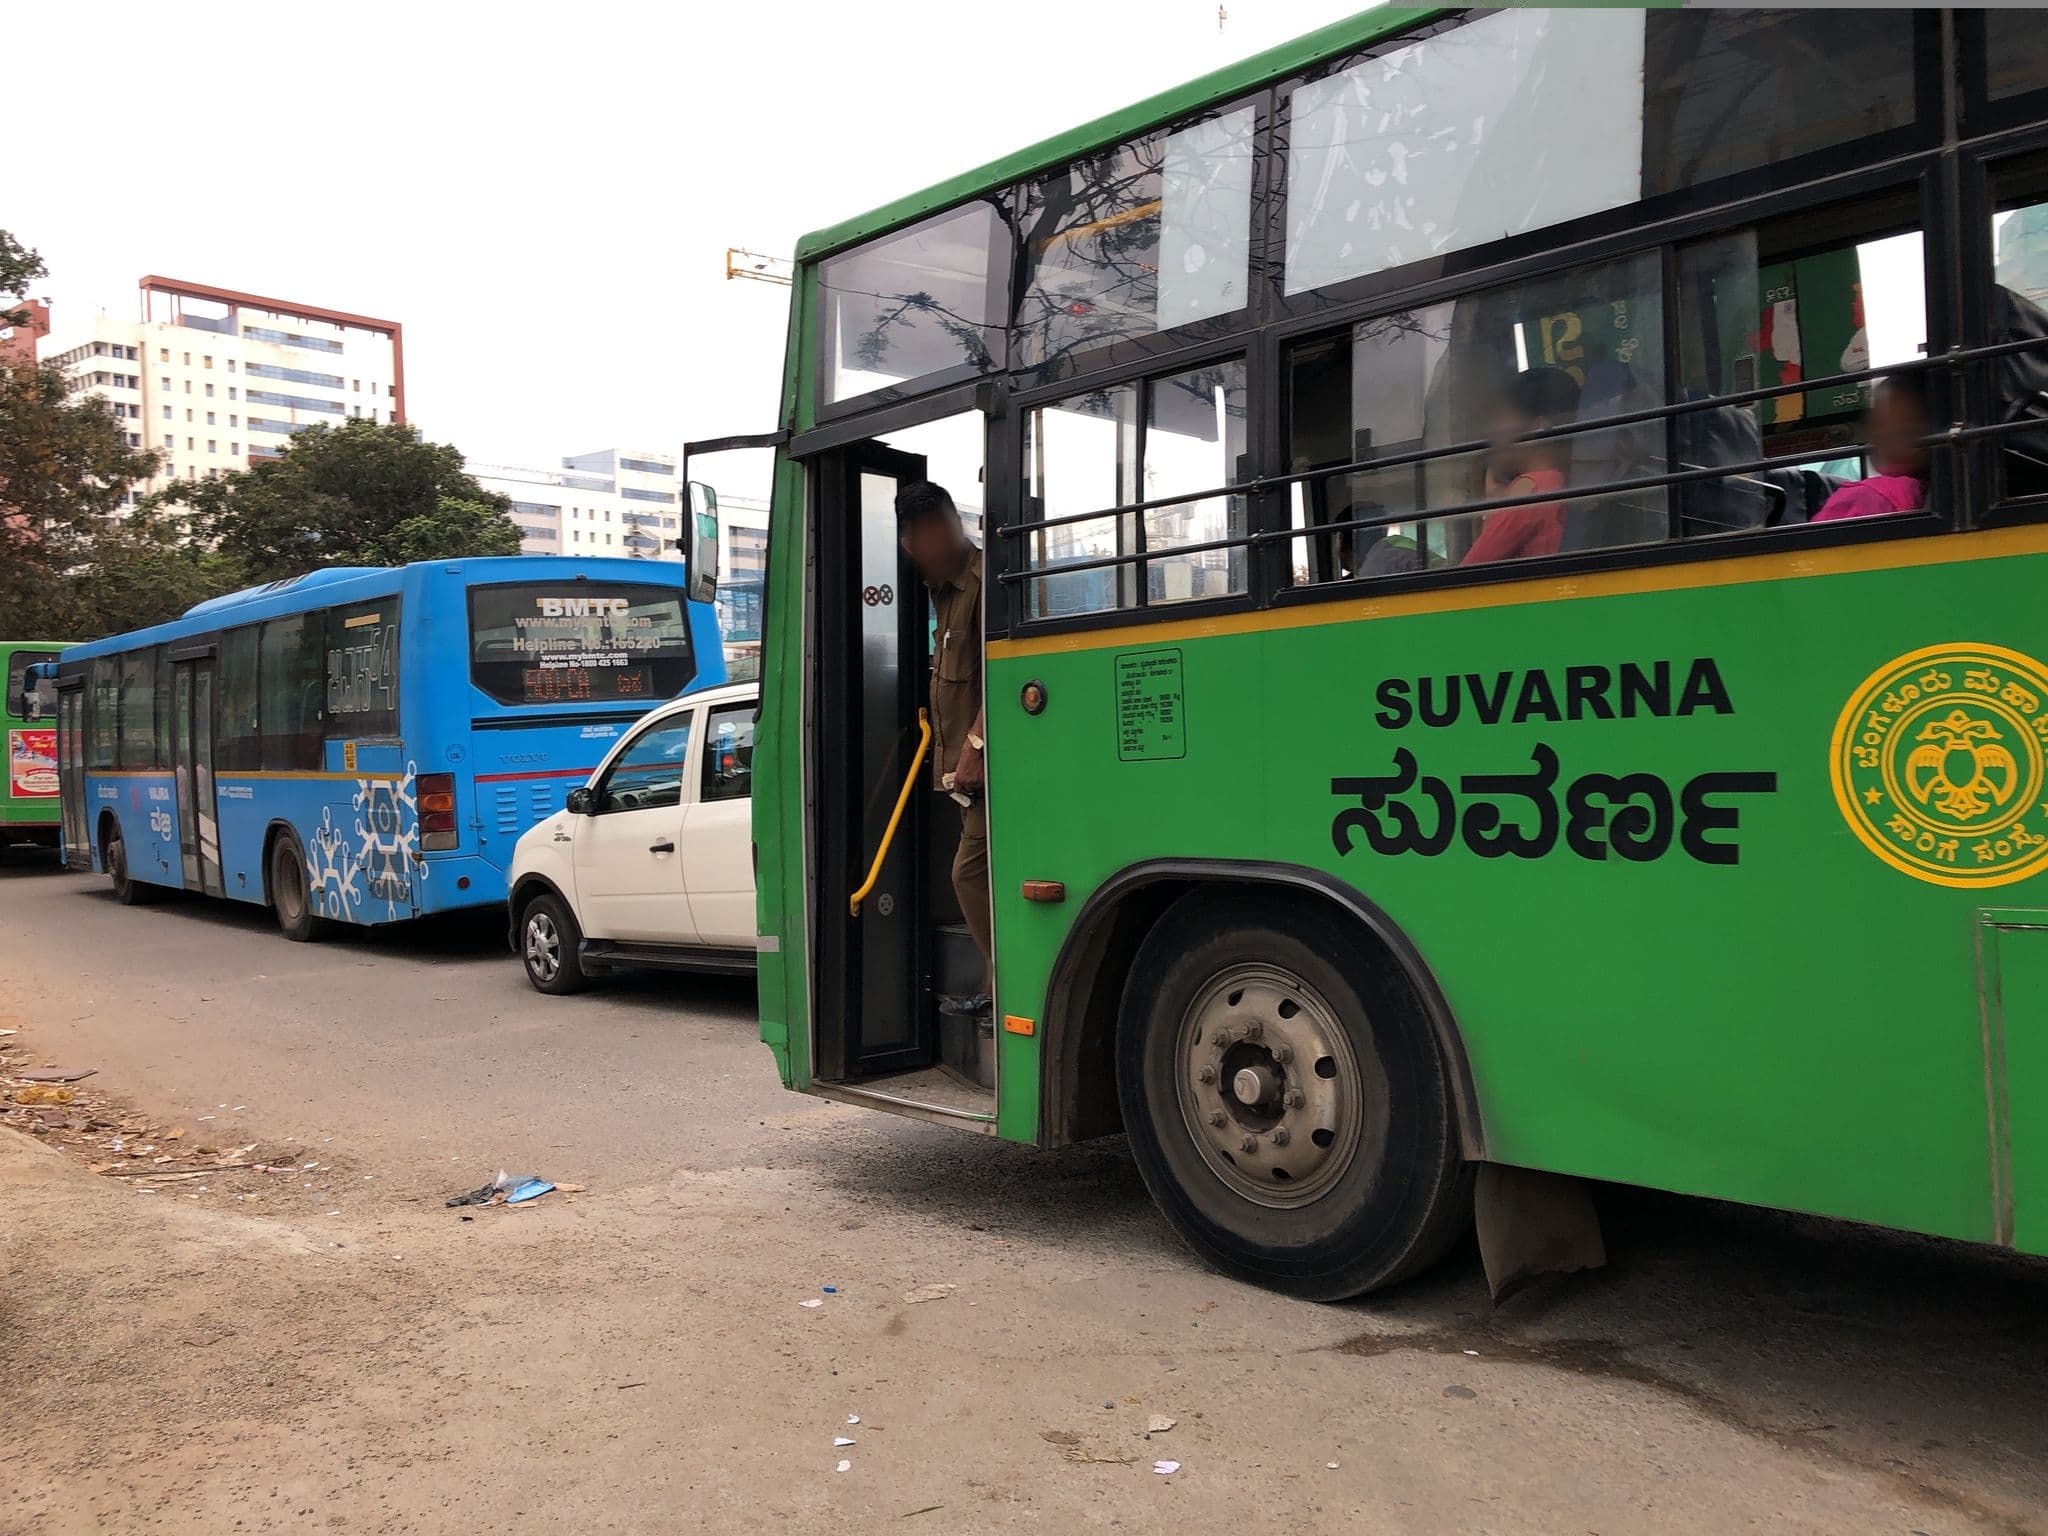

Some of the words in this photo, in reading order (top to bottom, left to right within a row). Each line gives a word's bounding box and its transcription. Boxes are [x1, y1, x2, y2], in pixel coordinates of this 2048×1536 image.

[542, 598, 630, 617] BMTC
[513, 638, 576, 653] Helpline
[541, 652, 628, 663] www.mybmtc.com
[1375, 657, 1735, 730] SUVARNA
[1853, 668, 1953, 769] ಬೆಂಗಳೂರು
[1331, 742, 1777, 866] ಸುವರ್ಣ
[1885, 813, 1960, 862] ಸಾರಿಗೆ
[1971, 823, 2046, 864] ಸಂಸ್ಥೆ
